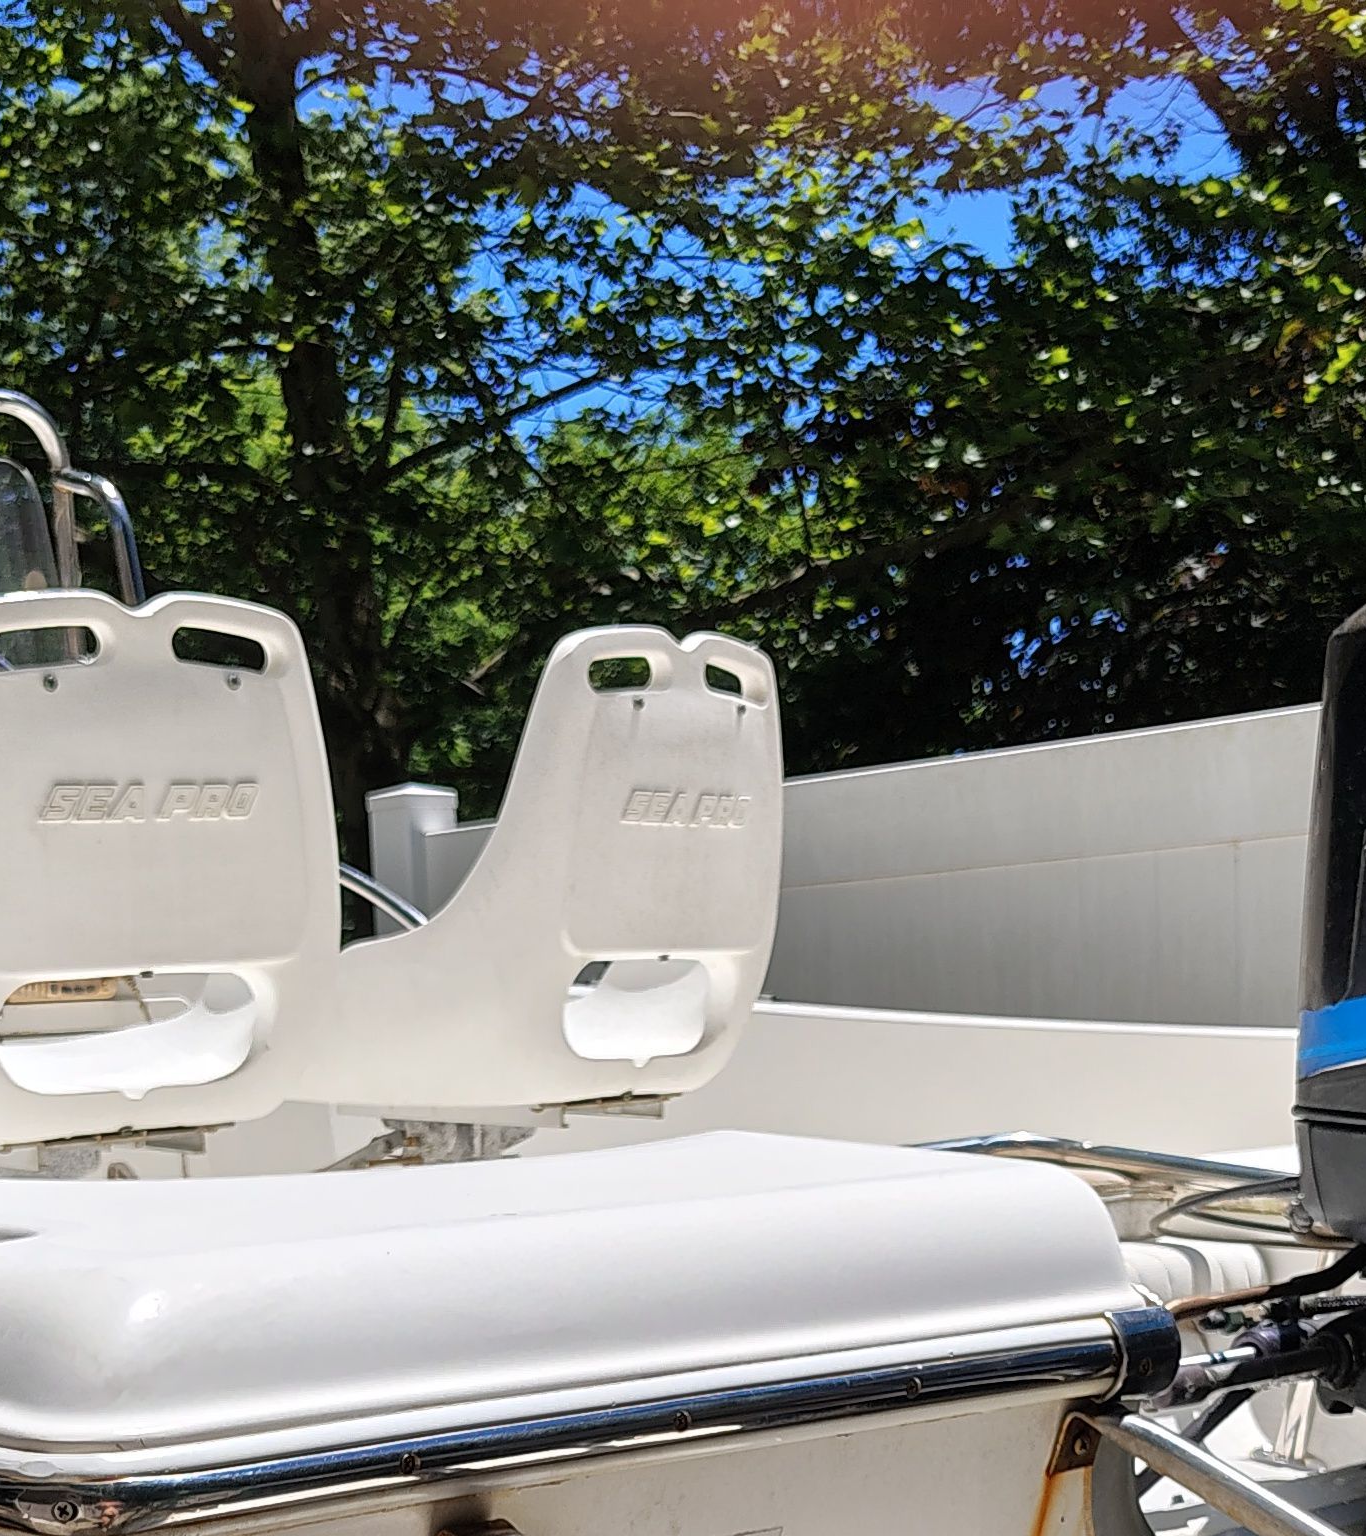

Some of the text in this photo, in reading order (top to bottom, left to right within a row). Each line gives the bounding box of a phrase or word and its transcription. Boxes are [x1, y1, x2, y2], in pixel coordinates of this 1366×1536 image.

[37, 783, 260, 823] SEA PRO
[619, 788, 751, 828] SEA PRO
